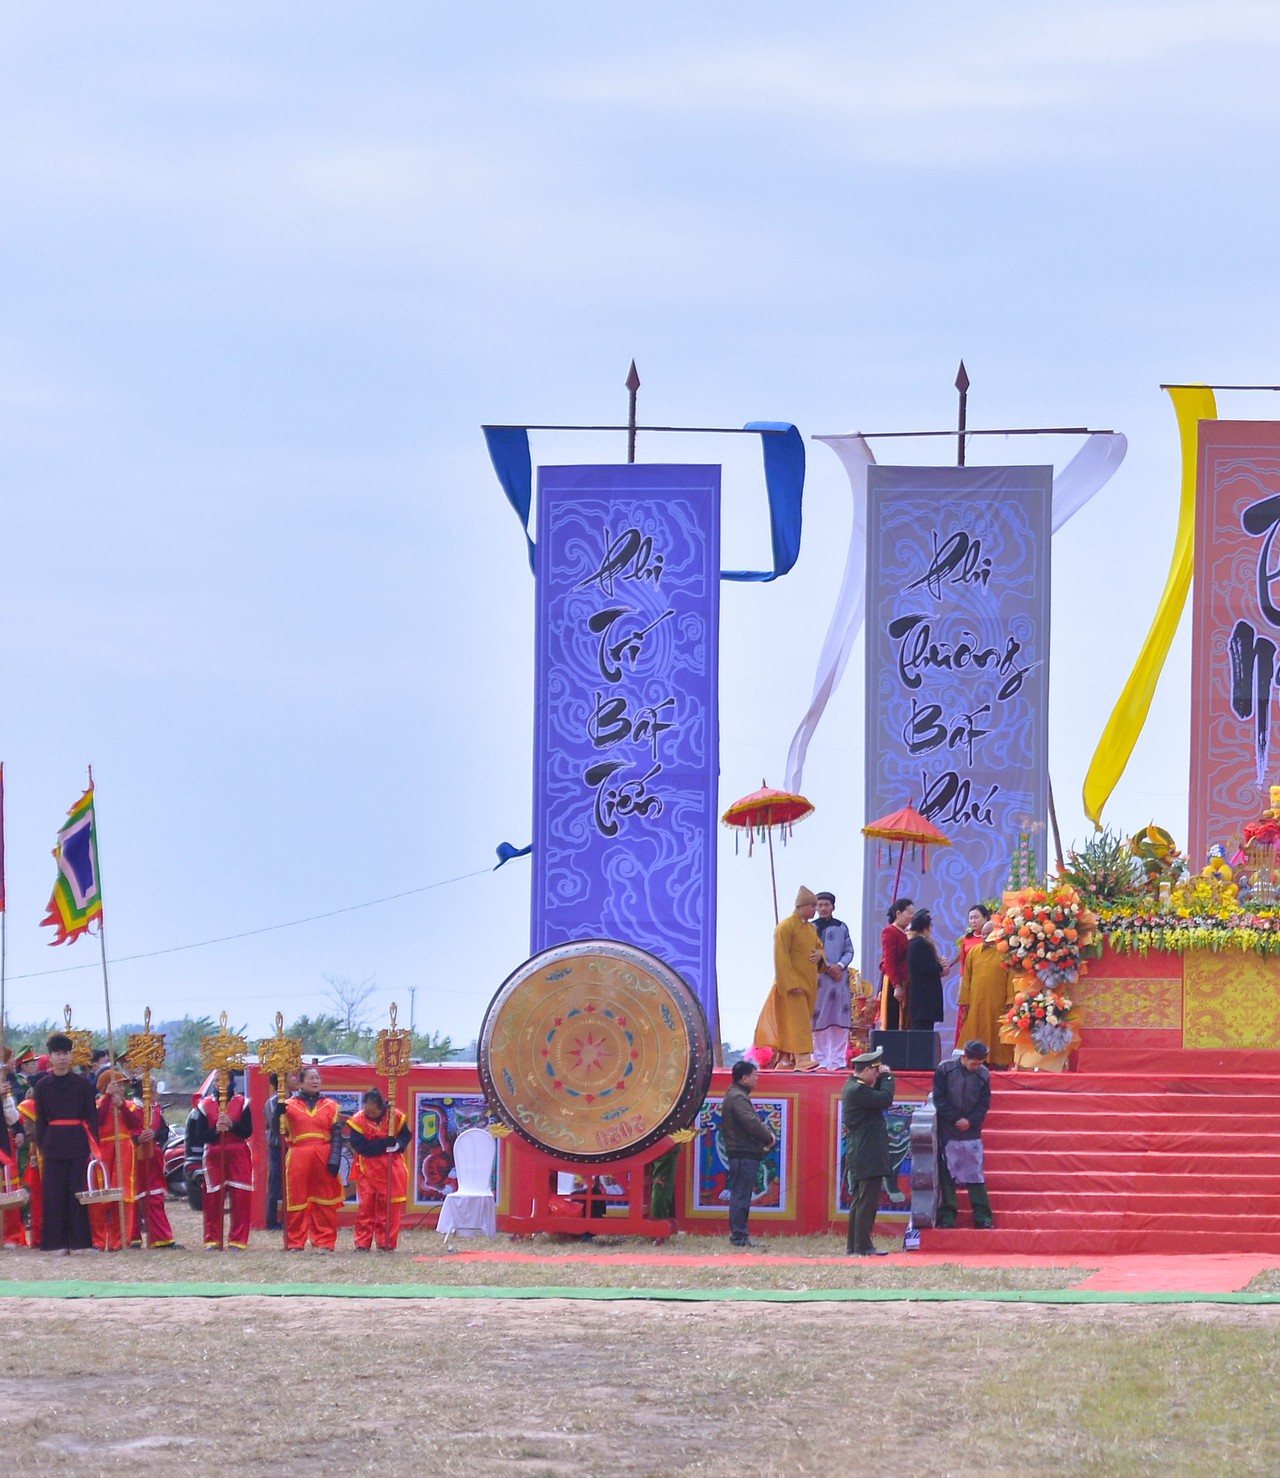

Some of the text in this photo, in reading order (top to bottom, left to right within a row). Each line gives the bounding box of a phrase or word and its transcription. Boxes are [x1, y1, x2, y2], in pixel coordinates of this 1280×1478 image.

[574, 528, 661, 598] Phi
[902, 530, 990, 600] Phi
[588, 607, 674, 683] Trí
[887, 614, 1043, 701] Thương
[587, 692, 678, 760] Bất
[904, 698, 993, 766] Bất
[585, 762, 662, 836] Tiến
[919, 771, 998, 826] Phú
